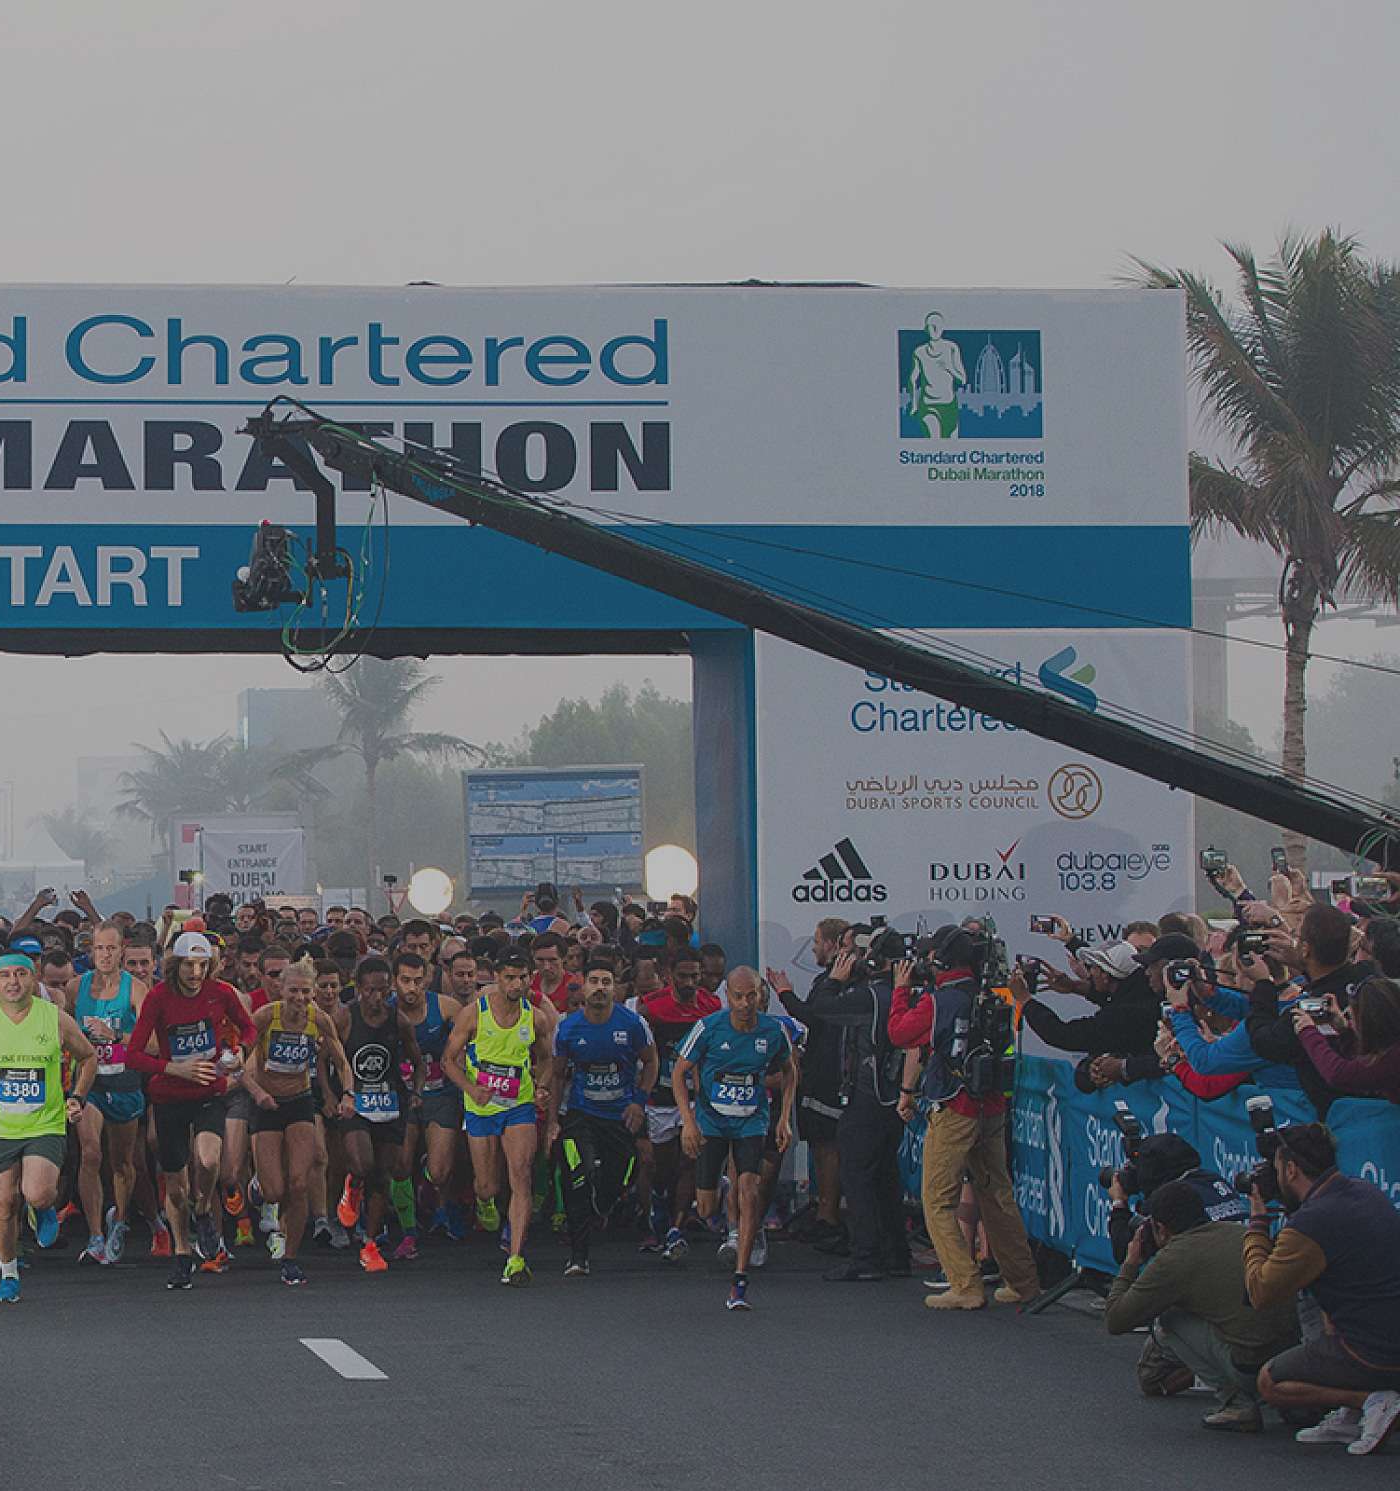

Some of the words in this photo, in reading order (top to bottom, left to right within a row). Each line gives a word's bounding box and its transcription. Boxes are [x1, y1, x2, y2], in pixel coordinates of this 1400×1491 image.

[65, 314, 669, 387] Chartered
[899, 451, 966, 465] Standard
[969, 451, 1045, 465] Chartered
[928, 467, 970, 481] Dubai
[973, 467, 1045, 481] Marathon
[1009, 484, 1045, 497] 2018
[851, 701, 1017, 732] Chartere
[846, 775, 918, 796] الرياضي
[923, 778, 963, 795] دبي
[969, 775, 1040, 795] مجلس
[846, 797, 896, 810] DUBAI
[901, 797, 963, 810] SPORTS
[969, 797, 1040, 810] COUNCIL
[237, 844, 268, 853] START
[227, 857, 278, 868] ENTRANCE
[230, 871, 275, 887] DUBAI
[929, 862, 1025, 881] DUBAI
[1059, 872, 1115, 891] 103.8
[792, 880, 888, 903] adidas
[929, 887, 1026, 901] HOLDING
[177, 1033, 210, 1050] 2461
[1, 1082, 40, 1097] 3380
[717, 1084, 754, 1101] 2429
[361, 1093, 392, 1107] 3416
